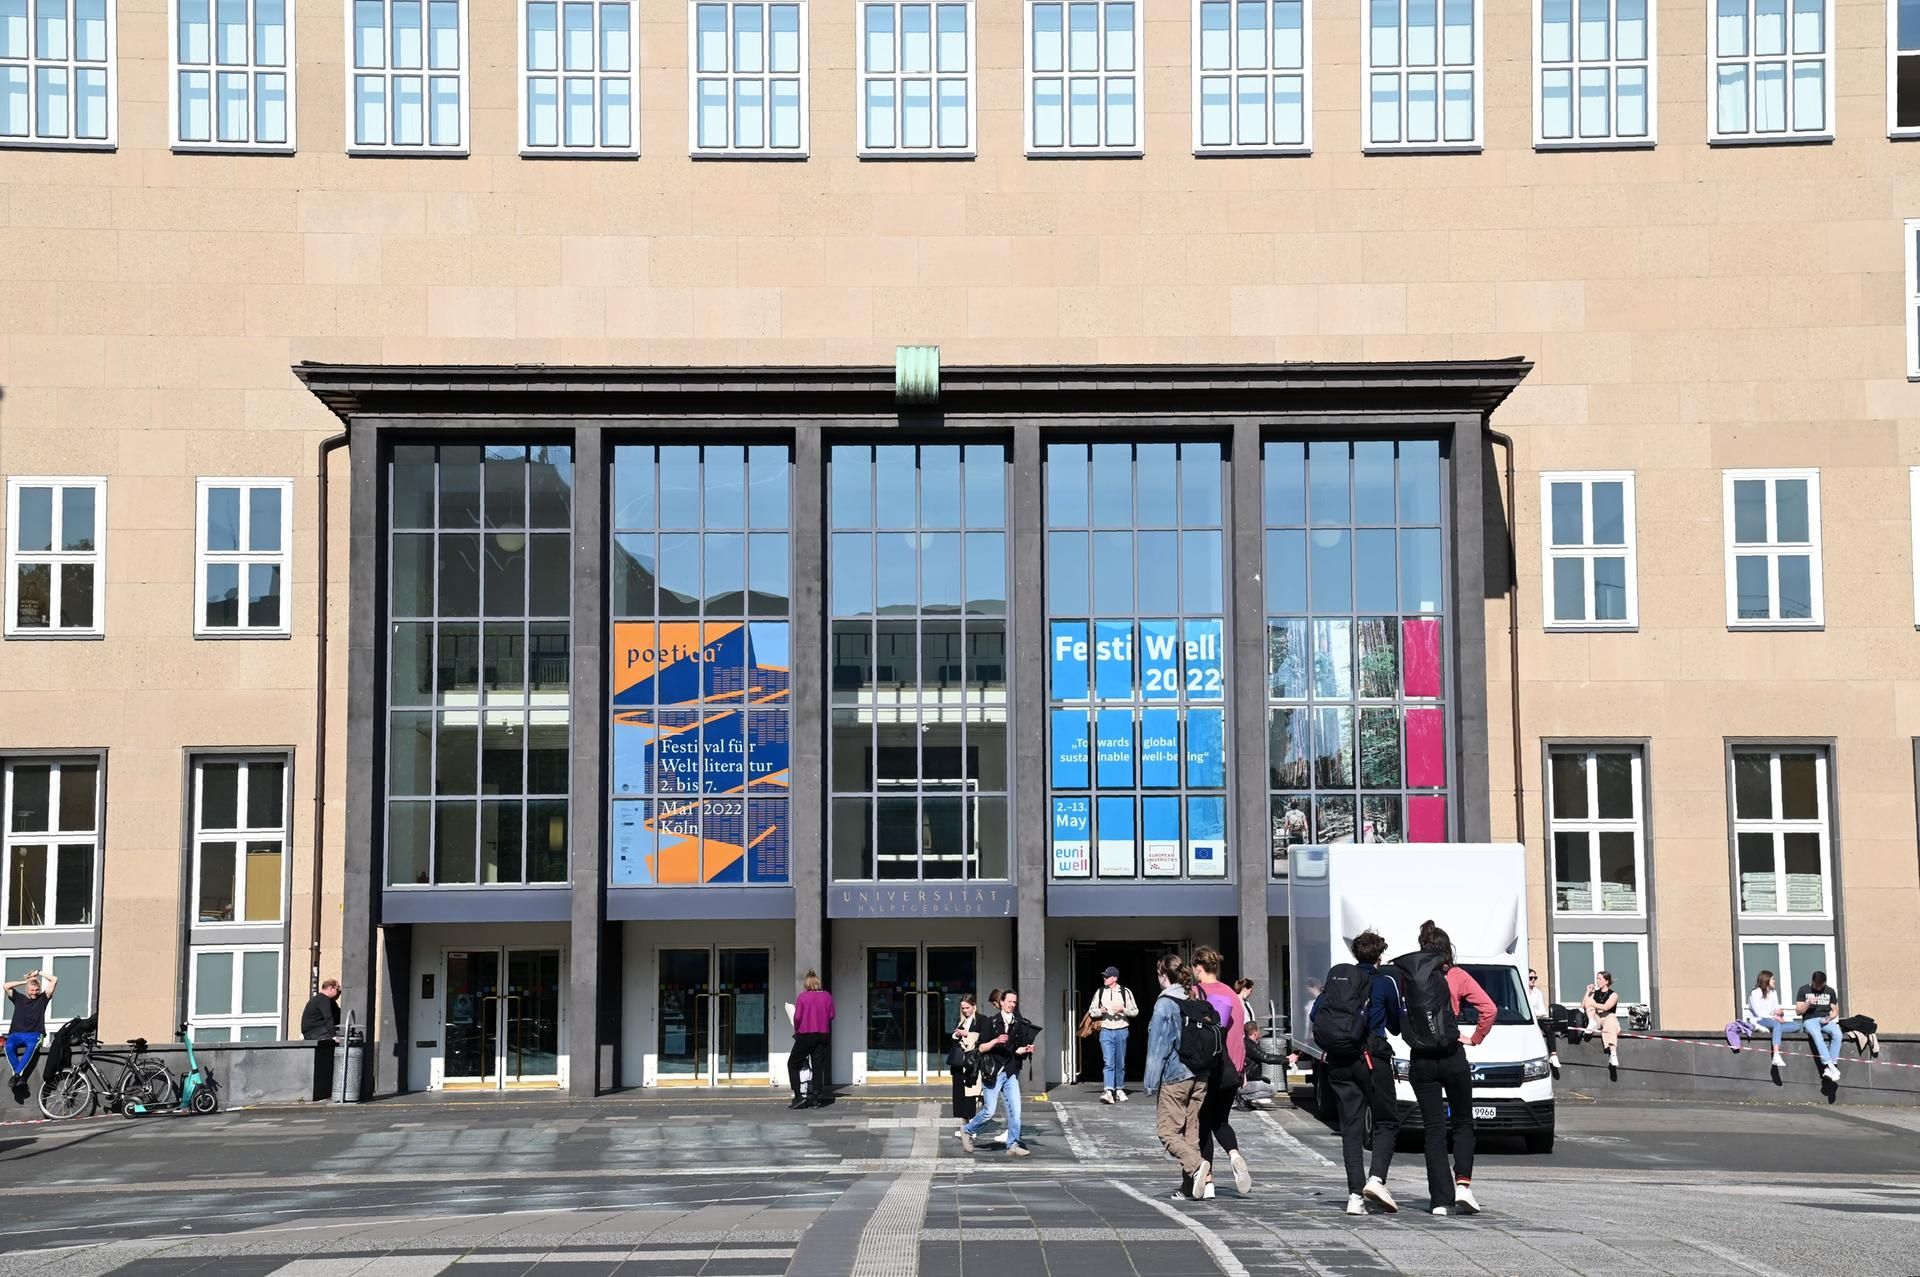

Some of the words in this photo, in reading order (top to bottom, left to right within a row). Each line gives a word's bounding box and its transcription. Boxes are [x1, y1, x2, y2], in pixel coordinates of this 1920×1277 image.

[1146, 668, 1220, 691] 2022
[661, 739, 725, 753] Festival
[728, 739, 756, 753] für
[1143, 736, 1176, 750] global
[1060, 751, 1130, 763] sustainable
[660, 780, 673, 791] 2.
[676, 777, 699, 791] bis
[705, 781, 717, 795] 7.
[661, 801, 693, 815] Mai
[704, 803, 742, 815] 2022
[661, 820, 698, 834] Köln
[1056, 814, 1087, 830] May
[1055, 845, 1083, 858] euni
[1059, 859, 1088, 871] well
[842, 889, 997, 902] UNIVERSITÄT
[1474, 1108, 1495, 1116] 9966
